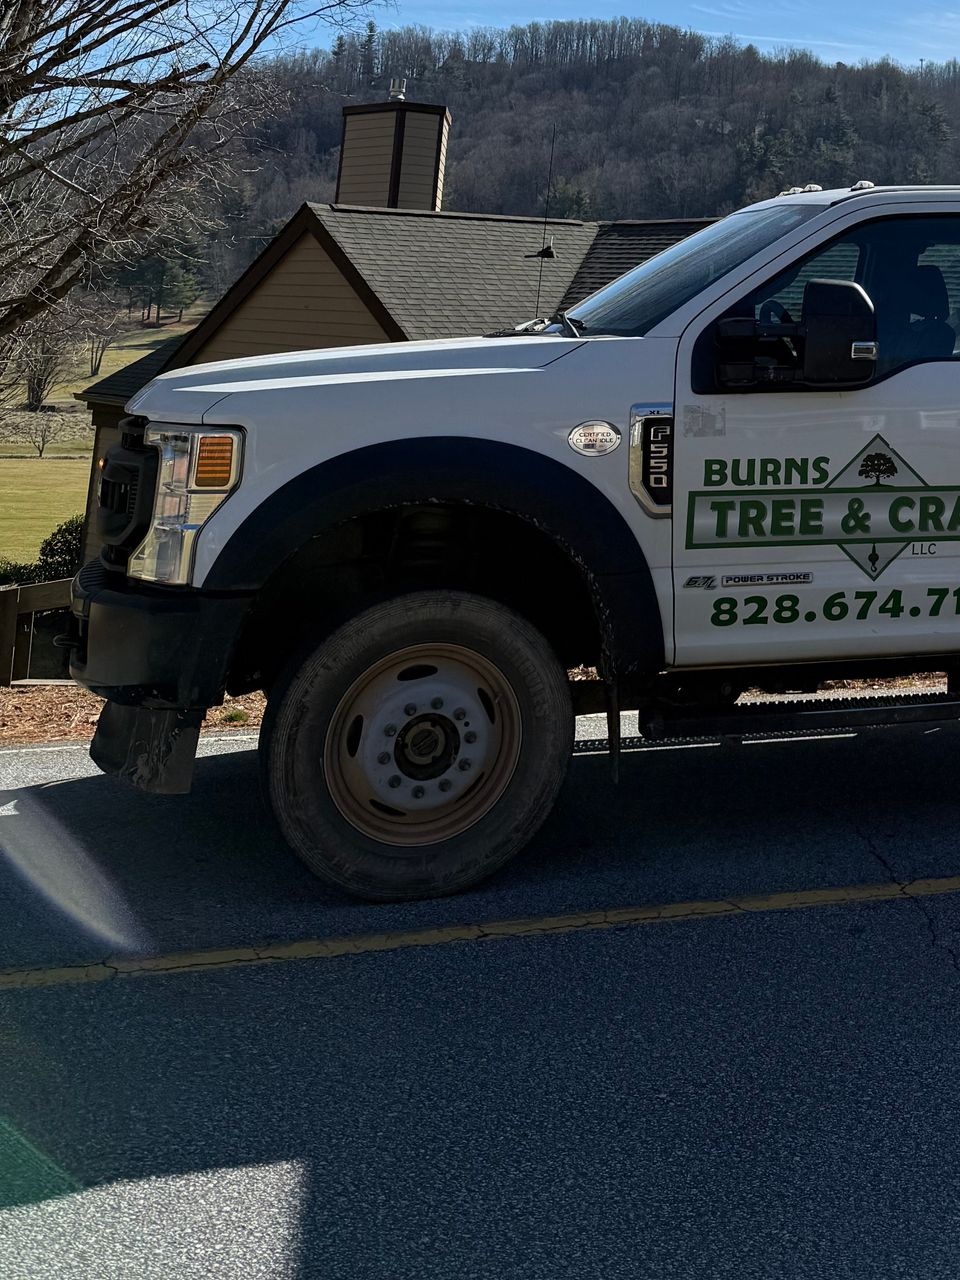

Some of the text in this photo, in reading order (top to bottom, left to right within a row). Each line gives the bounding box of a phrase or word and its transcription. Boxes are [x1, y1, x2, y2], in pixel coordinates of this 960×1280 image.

[703, 456, 830, 487] BURNS
[710, 498, 824, 538] TREE
[841, 497, 871, 535] &
[911, 543, 937, 555] LLC
[725, 575, 764, 584] POWER
[766, 573, 811, 582] STROKE
